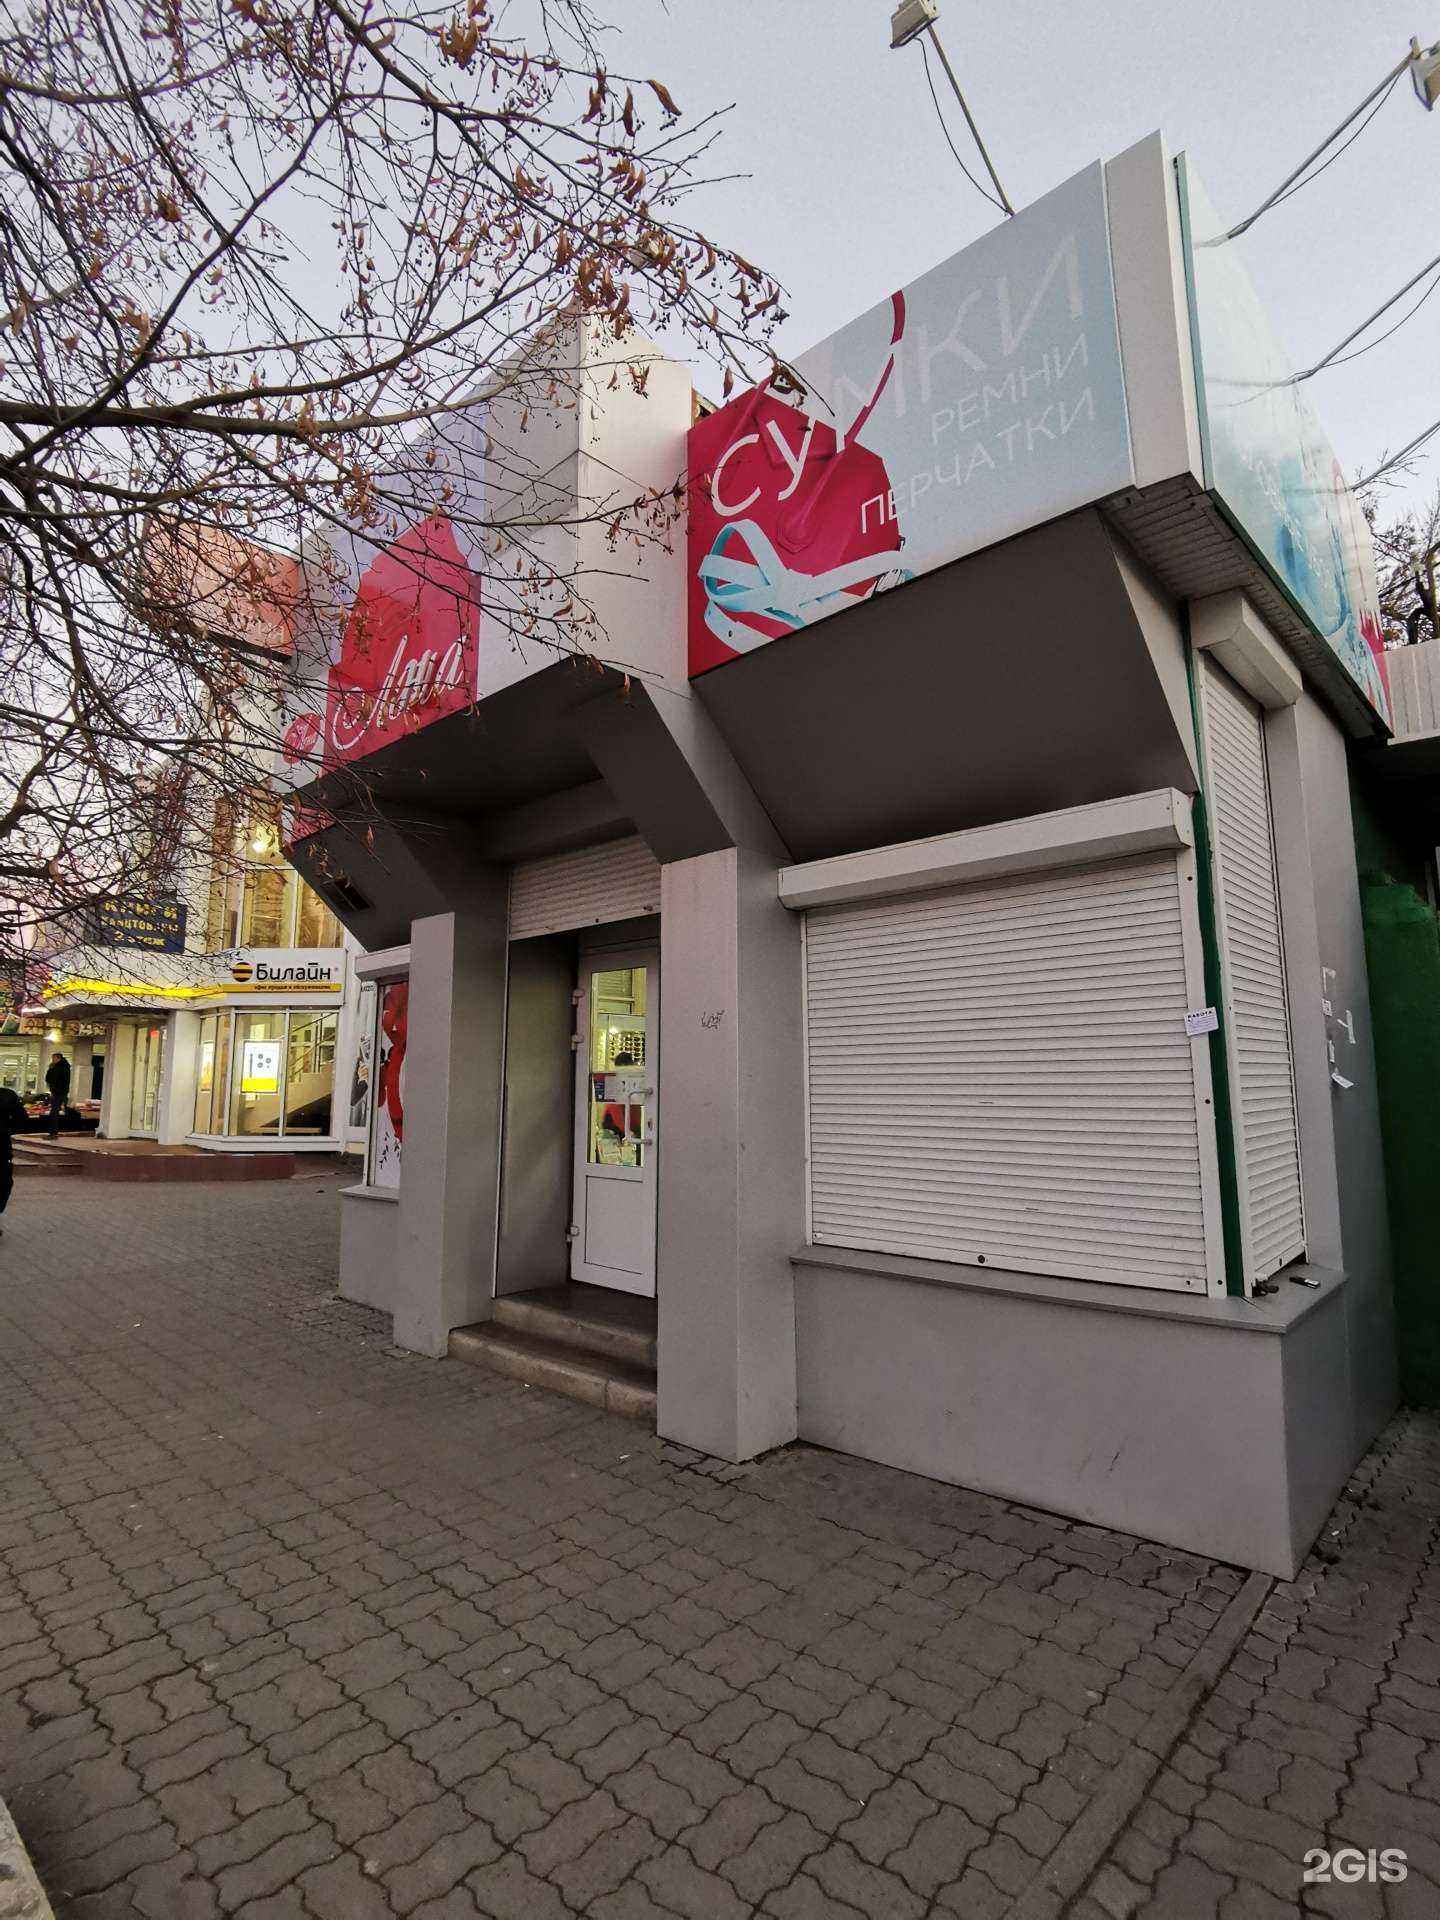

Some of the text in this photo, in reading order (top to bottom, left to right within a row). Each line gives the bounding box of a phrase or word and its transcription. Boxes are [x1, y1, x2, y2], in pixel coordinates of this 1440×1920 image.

[711, 232, 1085, 517] СУМКИ
[931, 332, 1089, 446] РЕМНИ
[860, 386, 1096, 535] ПЕРЧАТКИ
[256, 962, 331, 981] Билайн
